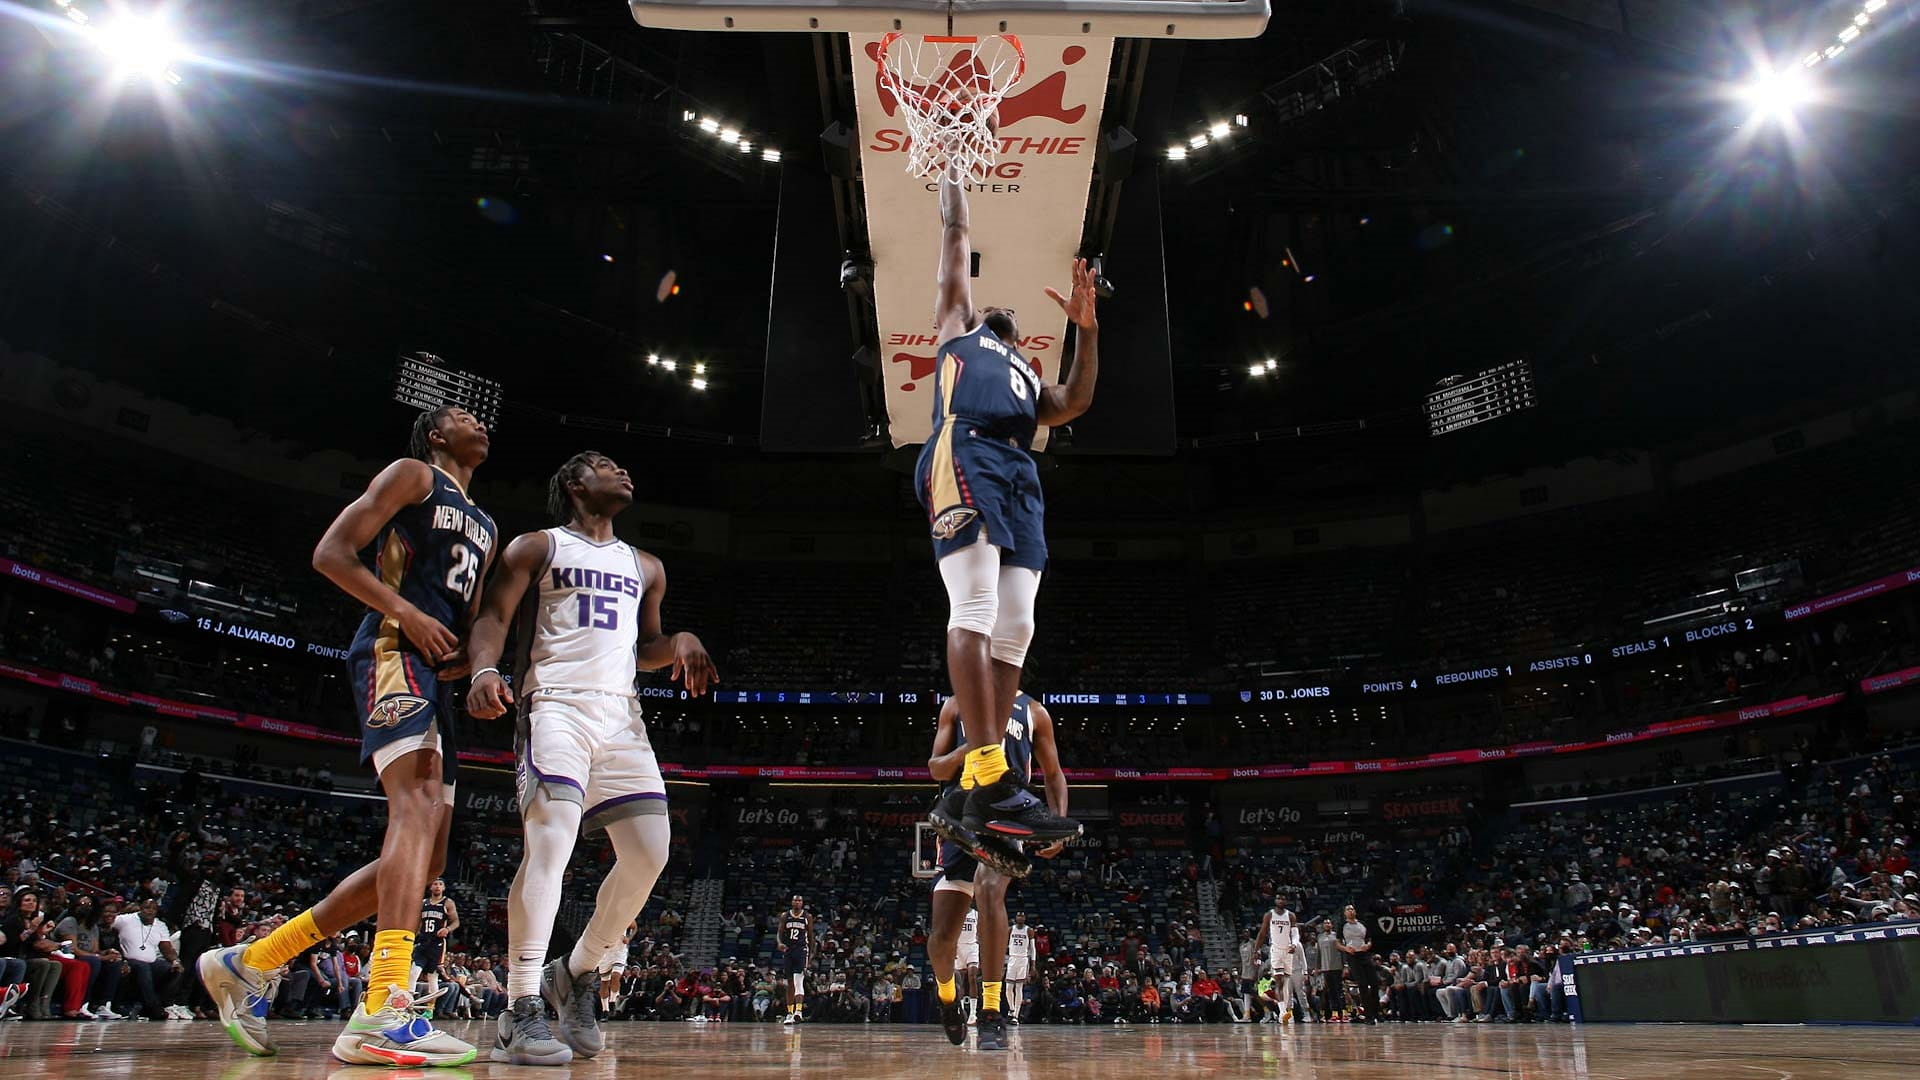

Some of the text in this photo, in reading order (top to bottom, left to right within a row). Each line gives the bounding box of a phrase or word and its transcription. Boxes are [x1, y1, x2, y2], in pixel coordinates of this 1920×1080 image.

[925, 183, 1021, 193] CNTER
[979, 335, 1008, 357] NEW
[1009, 366, 1027, 401] 8
[432, 505, 464, 532] NEW
[12, 563, 41, 581] ibotta
[446, 543, 479, 602] 25
[552, 567, 640, 599] KINGS
[576, 593, 618, 631] 15
[1784, 606, 1811, 619] ibotta
[196, 617, 349, 660] 15 J. ALVARADO POINTS
[1260, 618, 1754, 701] 30 D. JONES POINTS 4 REBOUNDS 1 ASSISTS 0 STEALS 1 BLOCKS 2
[637, 687, 688, 700] LOCKS 0
[755, 692, 760, 702] 1
[778, 692, 784, 702] 5
[899, 693, 917, 703] 123
[1050, 694, 1100, 704] KINGS
[1139, 694, 1170, 704] 3 1
[1738, 709, 1770, 720] ibotta
[261, 719, 289, 733] ibotta
[1606, 731, 1633, 742] ibotta
[1478, 748, 1506, 759] ibotta
[1354, 760, 1381, 771] ibotta
[758, 767, 784, 777] ibotta
[877, 768, 903, 777] ibotta
[1115, 769, 1141, 778] ibotta
[1233, 768, 1259, 777] ibotta
[466, 792, 520, 813] Let's G
[1383, 799, 1462, 818] SEATGEEK
[738, 807, 799, 825] Let's Go
[1119, 811, 1185, 827] SEATGEEK
[1239, 806, 1300, 824] Let's Go
[1088, 836, 1102, 848] Go
[424, 920, 436, 932] 15
[1278, 926, 1283, 934] 7
[790, 928, 800, 940] 12
